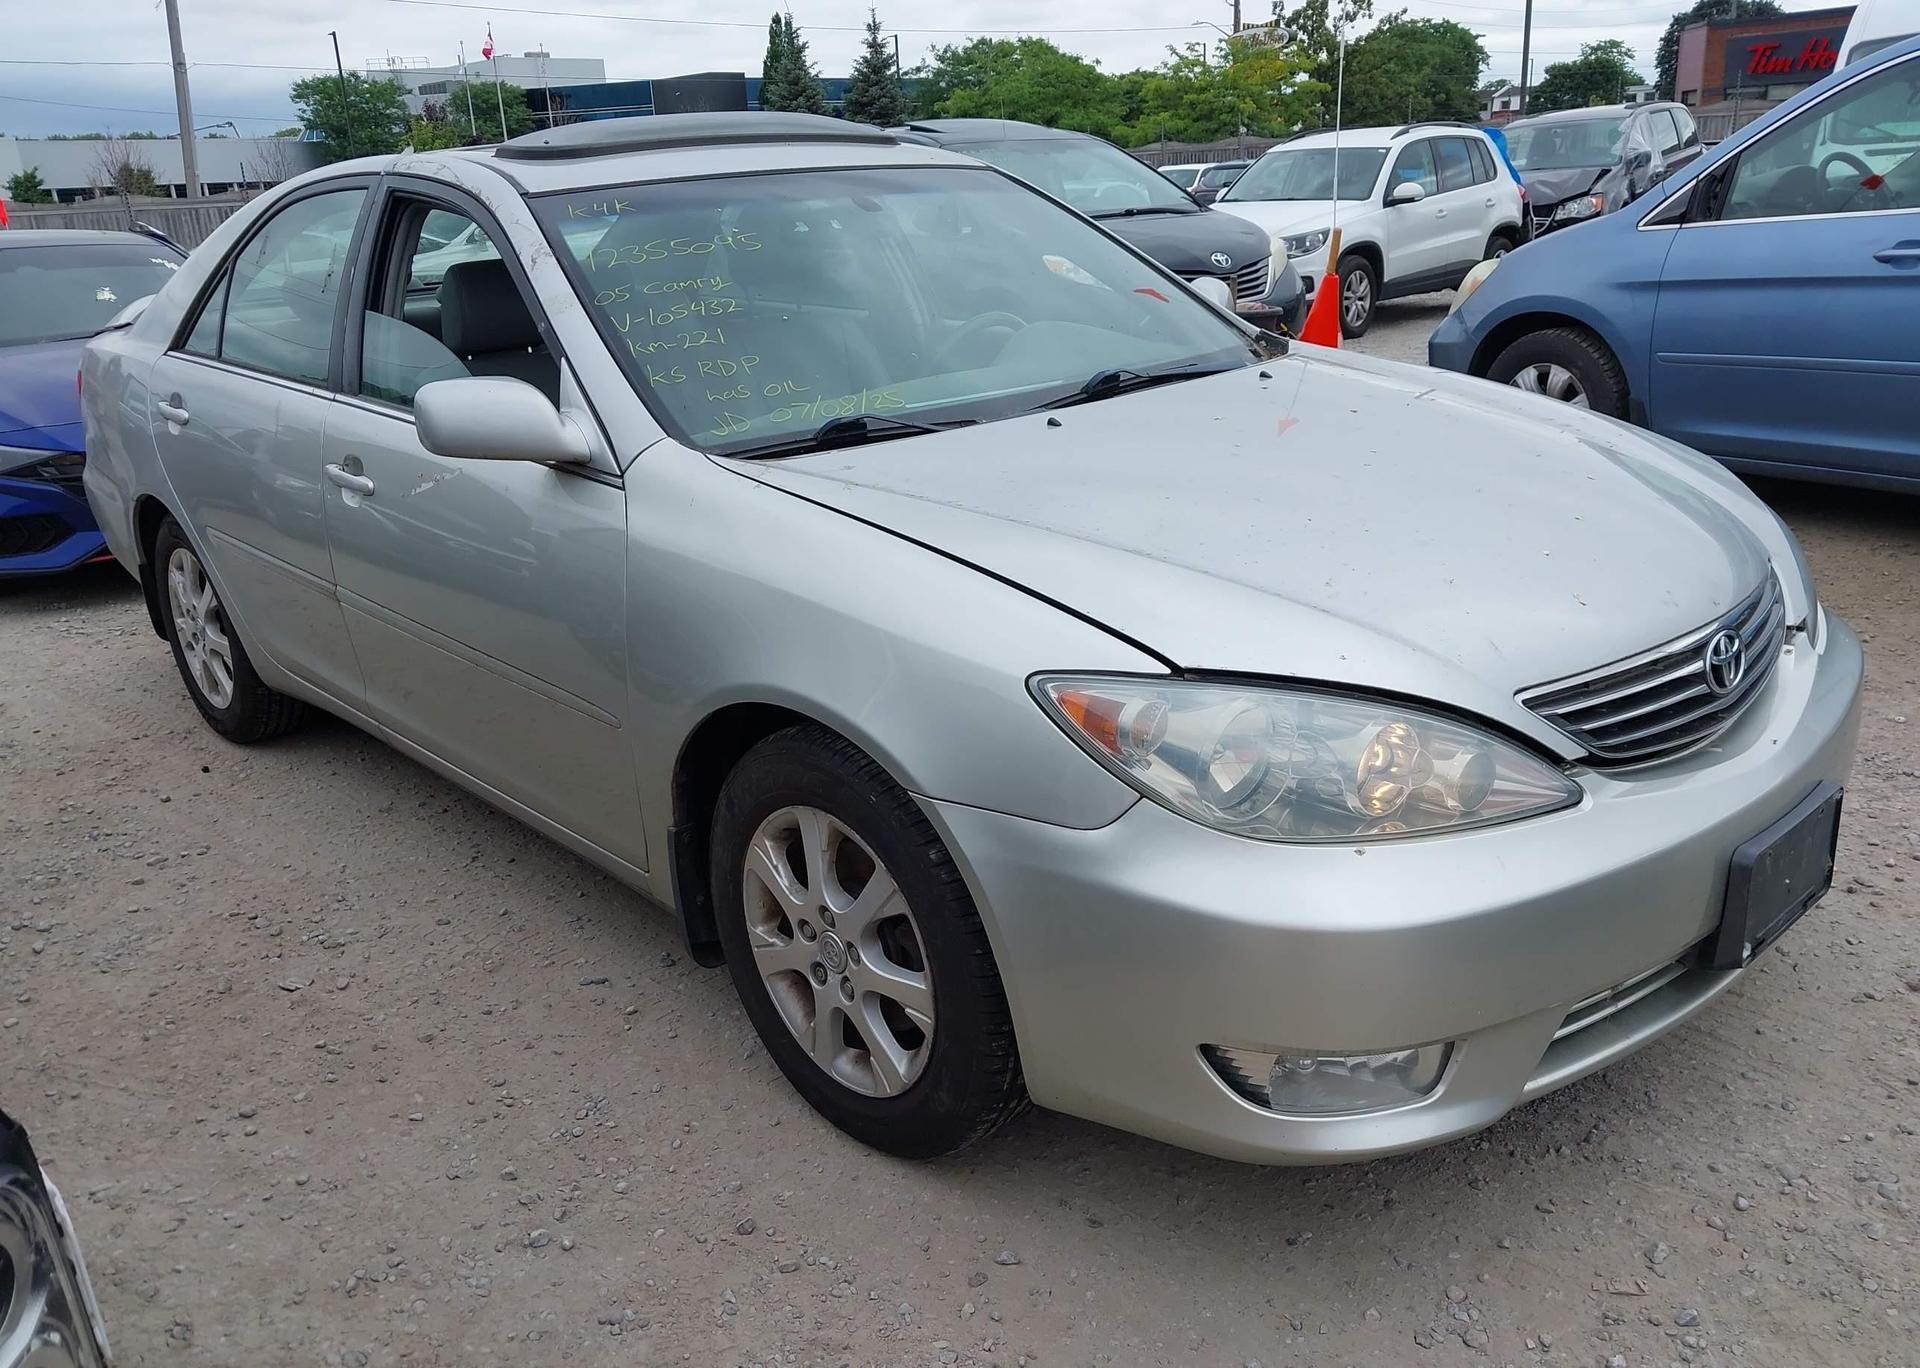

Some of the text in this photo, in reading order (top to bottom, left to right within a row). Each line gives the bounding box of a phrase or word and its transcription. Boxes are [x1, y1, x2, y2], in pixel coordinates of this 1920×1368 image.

[1746, 42, 1792, 74] Tim
[594, 284, 631, 305] 05
[698, 355, 760, 377] RDP
[705, 384, 751, 402] has
[710, 388, 904, 436] JD 07/08/25
